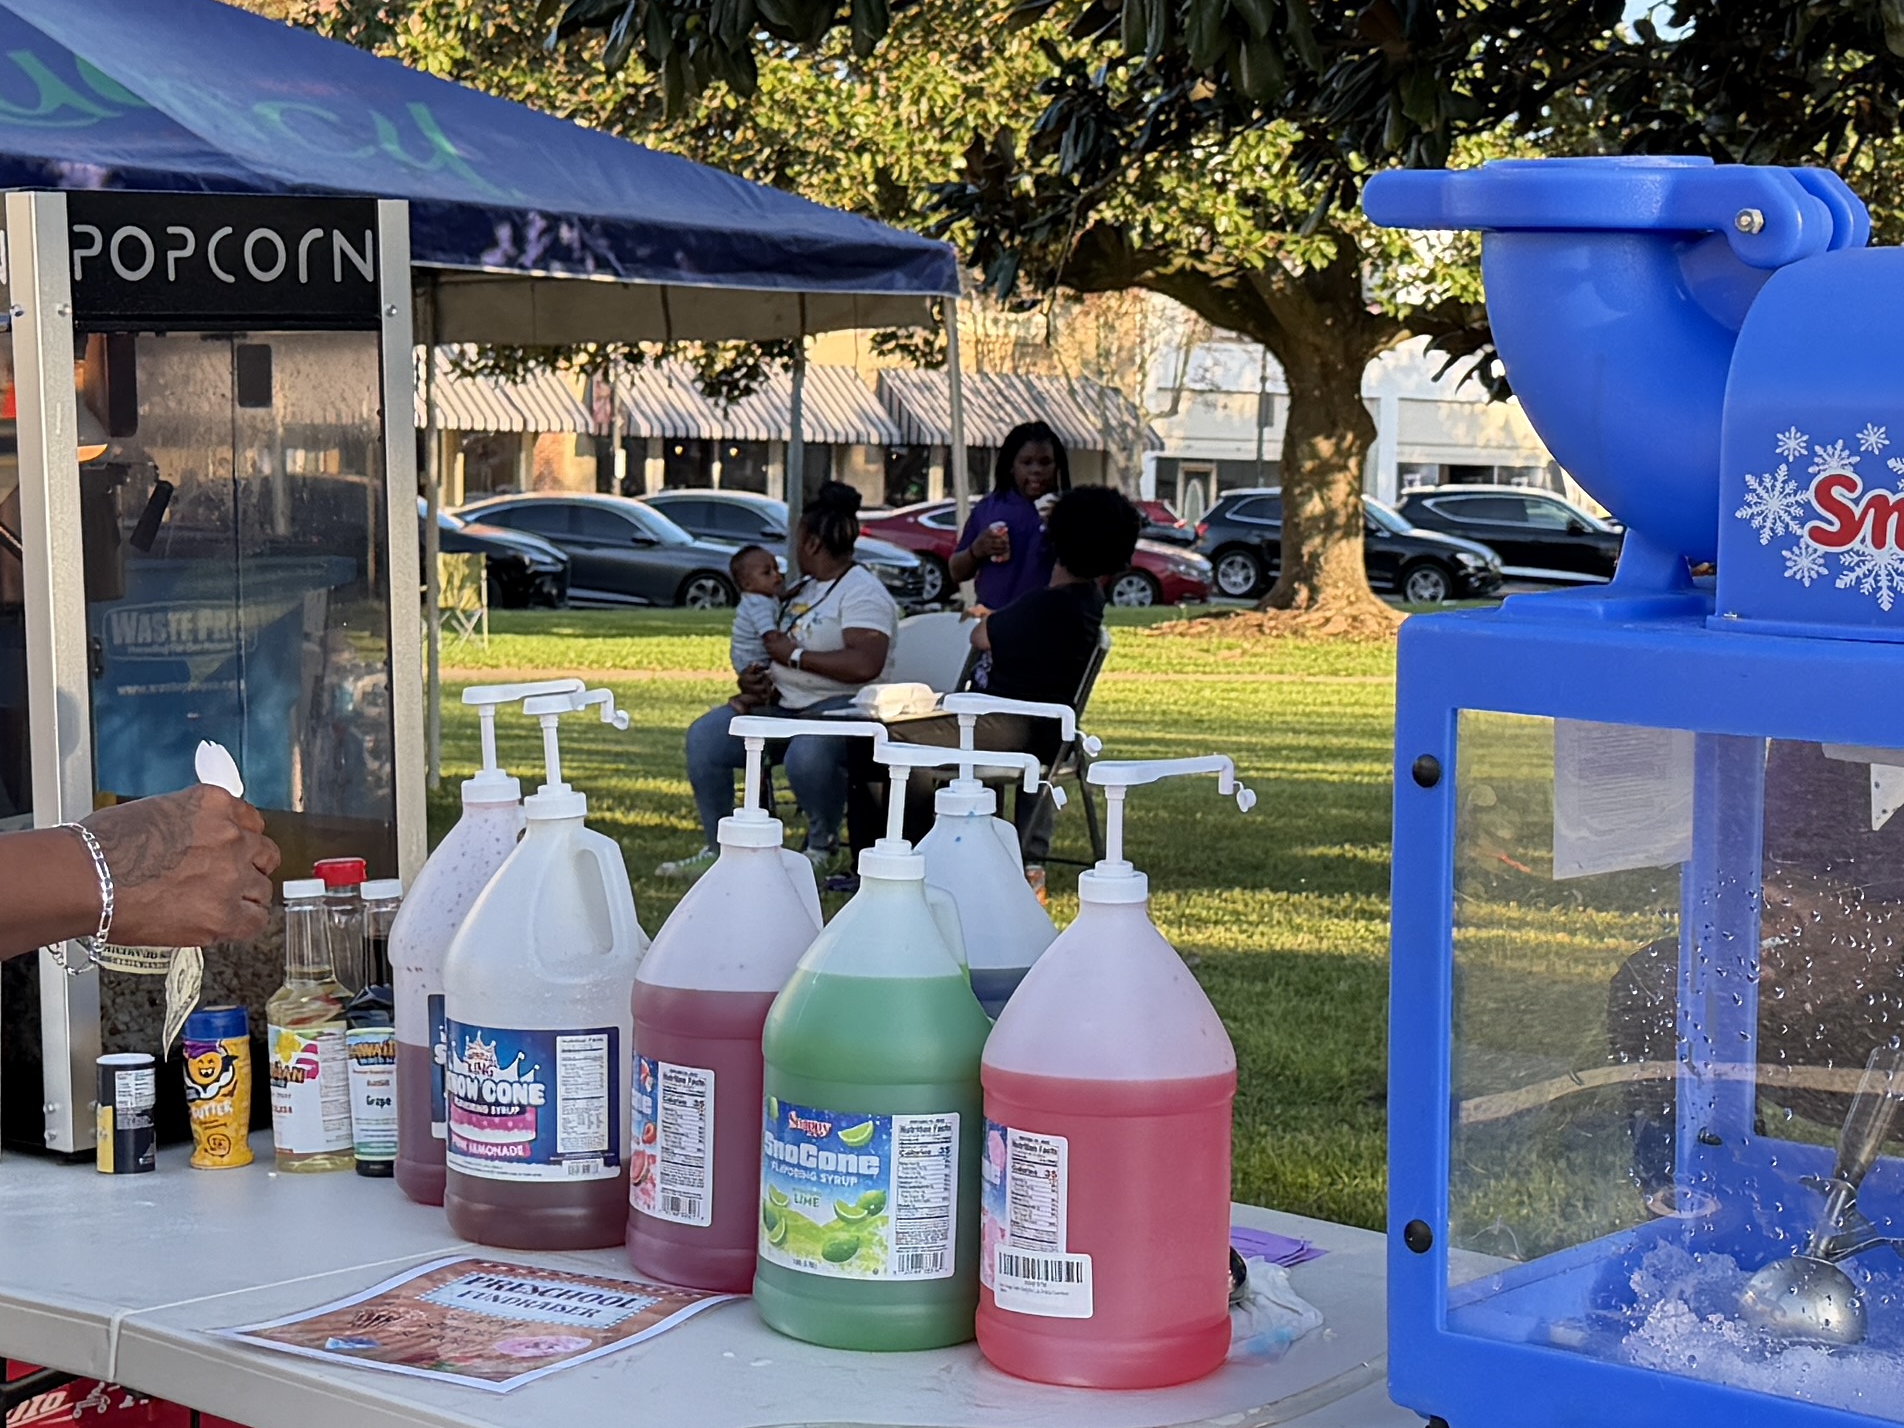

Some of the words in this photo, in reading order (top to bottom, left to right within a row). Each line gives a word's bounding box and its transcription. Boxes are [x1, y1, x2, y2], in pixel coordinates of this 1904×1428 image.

[73, 224, 375, 284] POPCORN
[110, 610, 193, 645] WASTE
[366, 1095, 392, 1109] Grape
[482, 1078, 546, 1105] CONE
[764, 1130, 880, 1176] SnoCone
[819, 1173, 859, 1188] SYRUP
[793, 1194, 820, 1209] LIME
[456, 1290, 600, 1319] FUNDRAISER
[464, 1274, 641, 1310] PRESCHOOL
